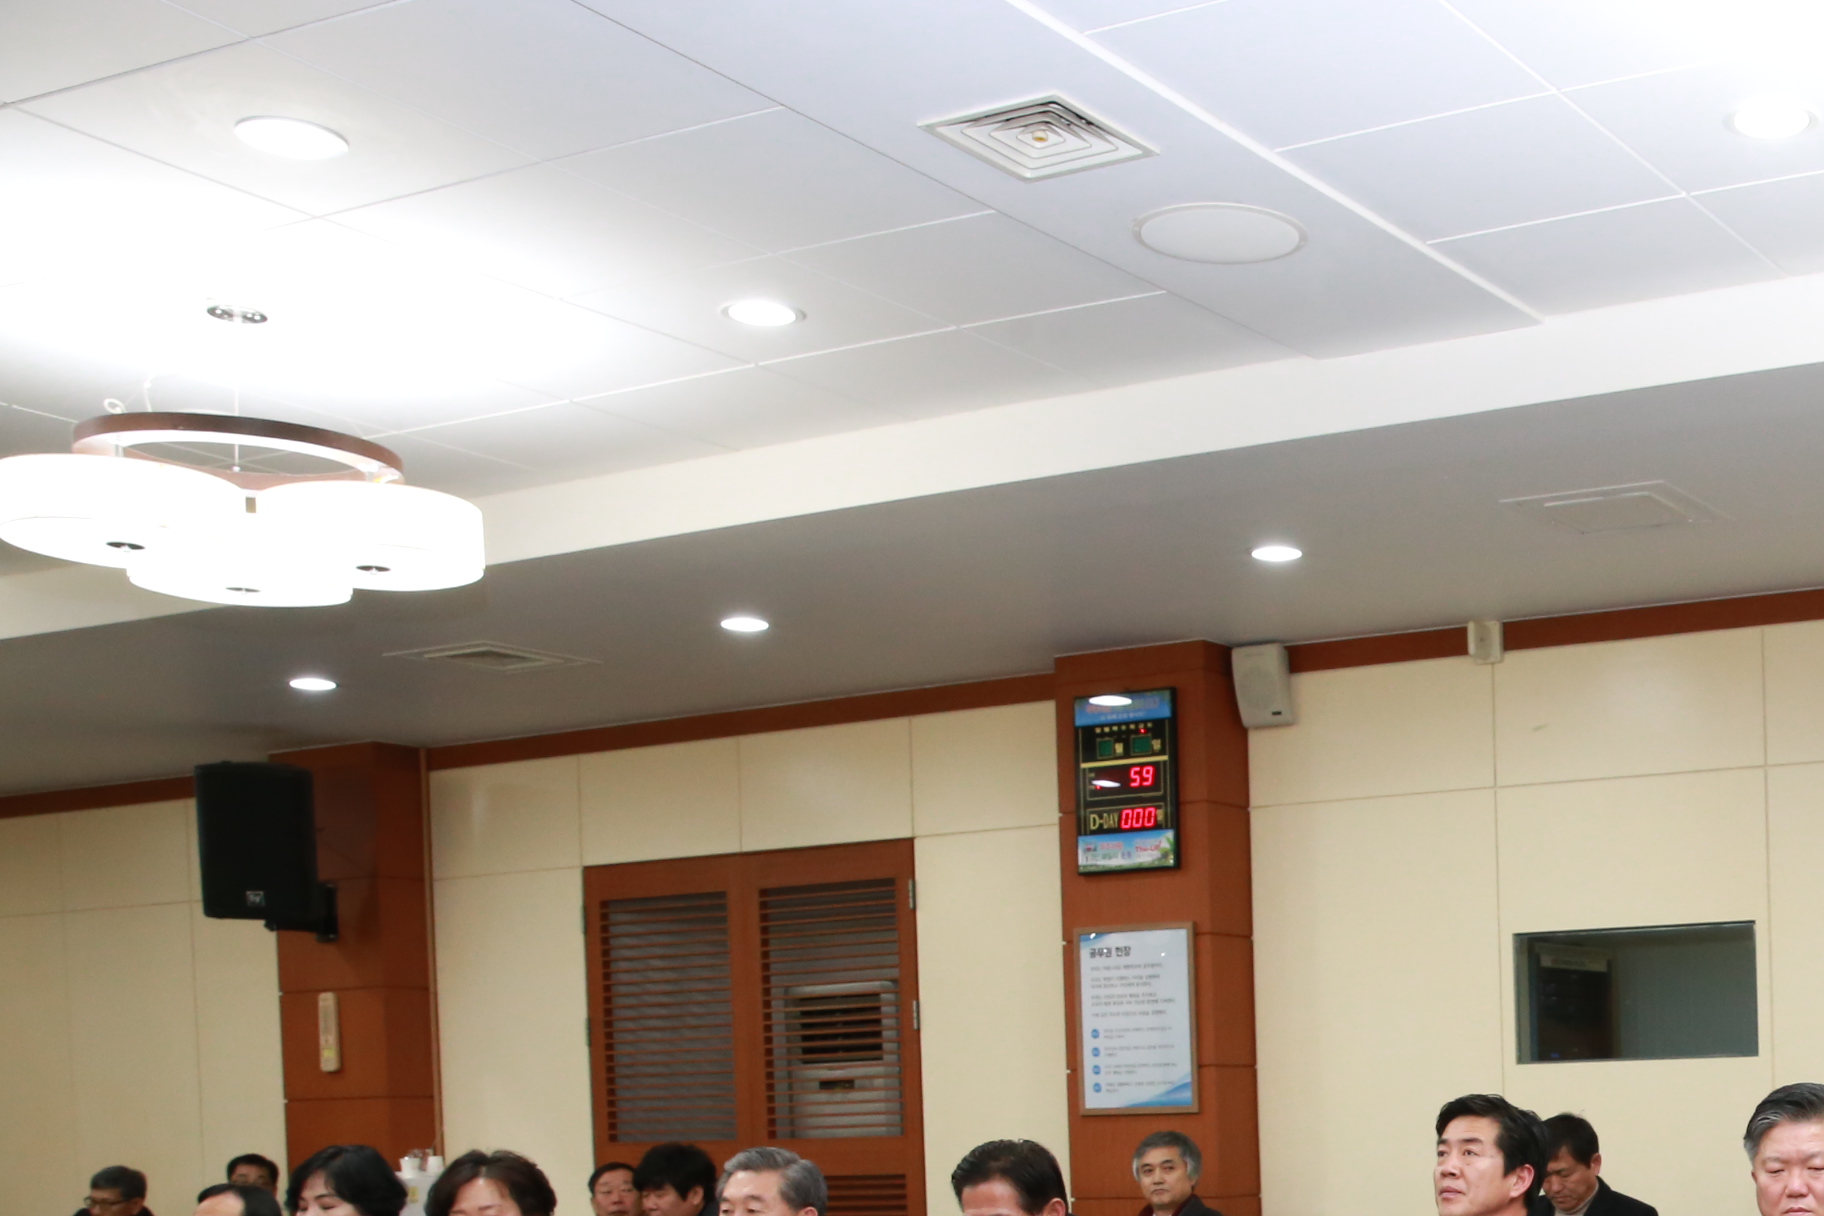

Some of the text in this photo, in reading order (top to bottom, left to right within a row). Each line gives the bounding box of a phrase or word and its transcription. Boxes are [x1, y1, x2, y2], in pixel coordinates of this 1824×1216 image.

[1130, 765, 1155, 787] 59
[1090, 813, 1119, 830] D-DAY
[1120, 807, 1156, 829] 000
